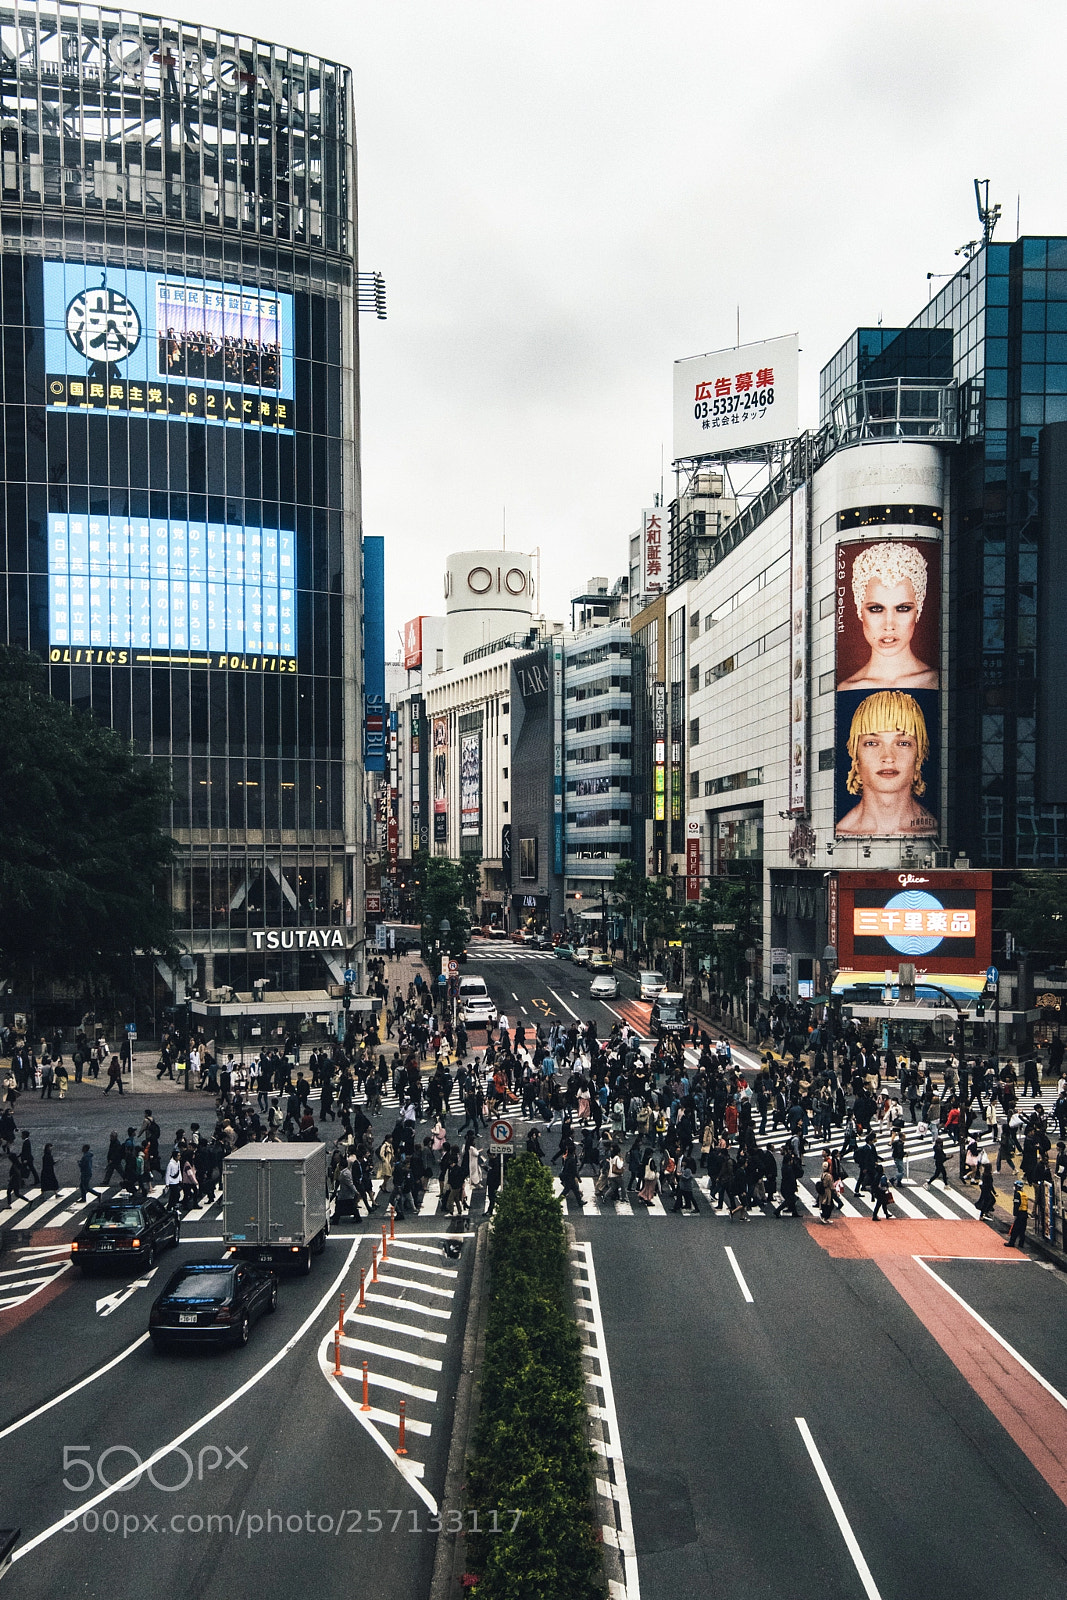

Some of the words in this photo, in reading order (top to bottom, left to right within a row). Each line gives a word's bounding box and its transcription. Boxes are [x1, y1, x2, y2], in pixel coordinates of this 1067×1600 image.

[159, 287, 279, 316] 国民民主党設立大会
[694, 367, 775, 402] 広告募集
[694, 387, 775, 420] 03-5337-2468
[646, 514, 662, 576] 大和証券
[838, 548, 846, 579] 4.28
[218, 656, 297, 673] POLITICS
[366, 694, 384, 756] SEIBU
[898, 873, 930, 887] Glico
[368, 899, 378, 909] 本
[859, 911, 971, 932] 三千里薬品
[252, 929, 344, 949] TSUTAYA
